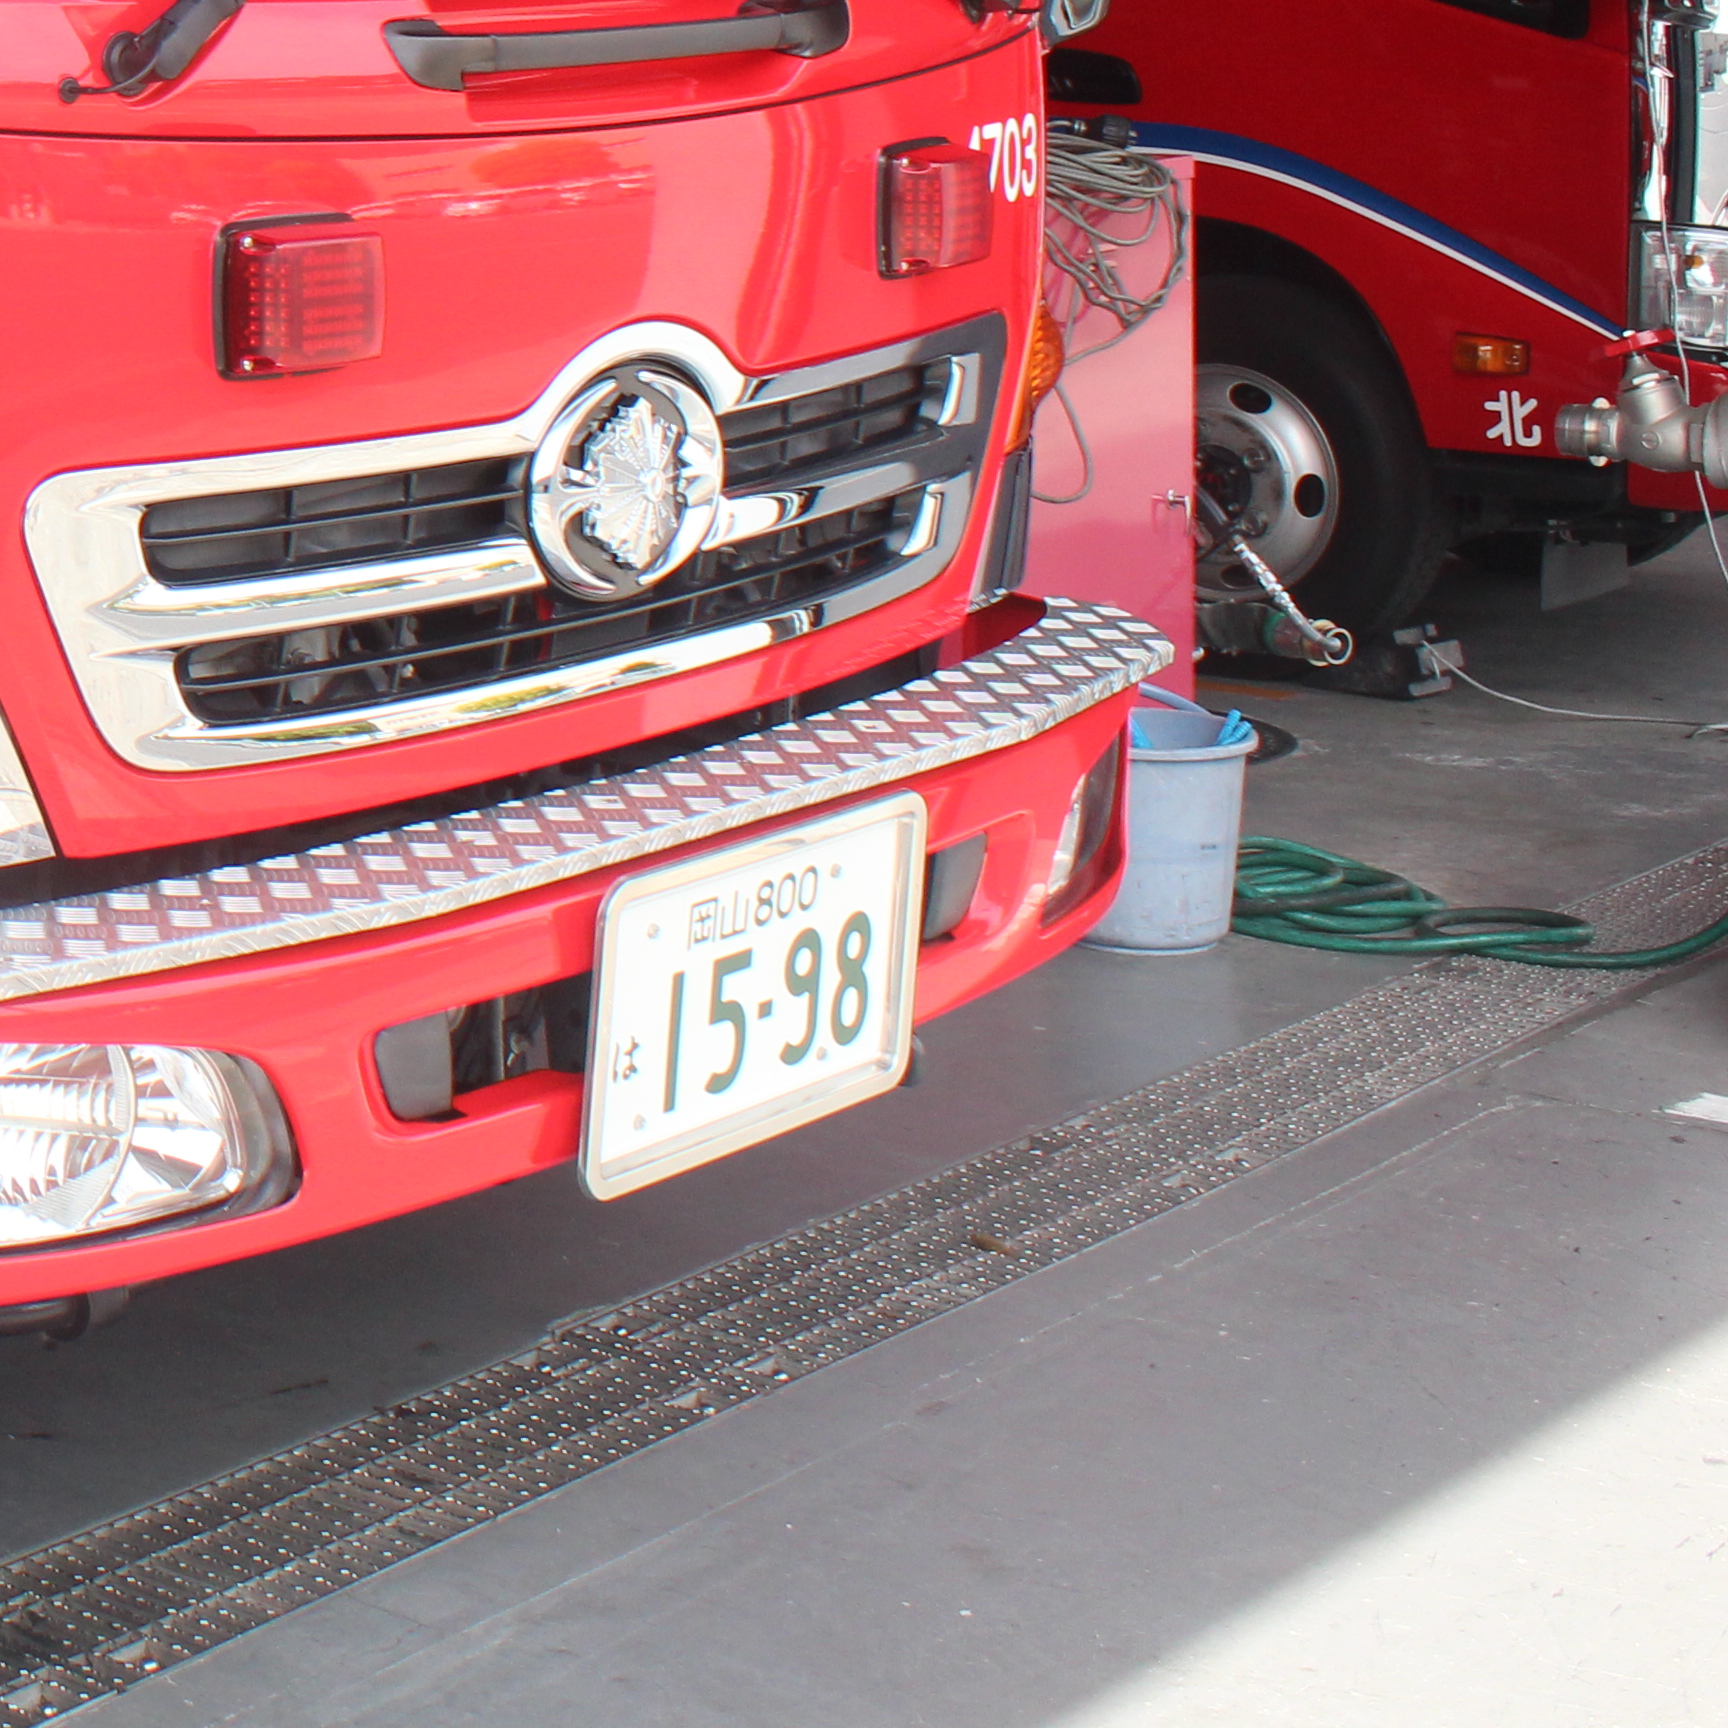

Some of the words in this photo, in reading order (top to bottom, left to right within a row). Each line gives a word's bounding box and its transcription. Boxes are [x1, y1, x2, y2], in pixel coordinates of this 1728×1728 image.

[1483, 388, 1544, 449] 北
[612, 1035, 641, 1083] は
[663, 910, 872, 1114] 15-98
